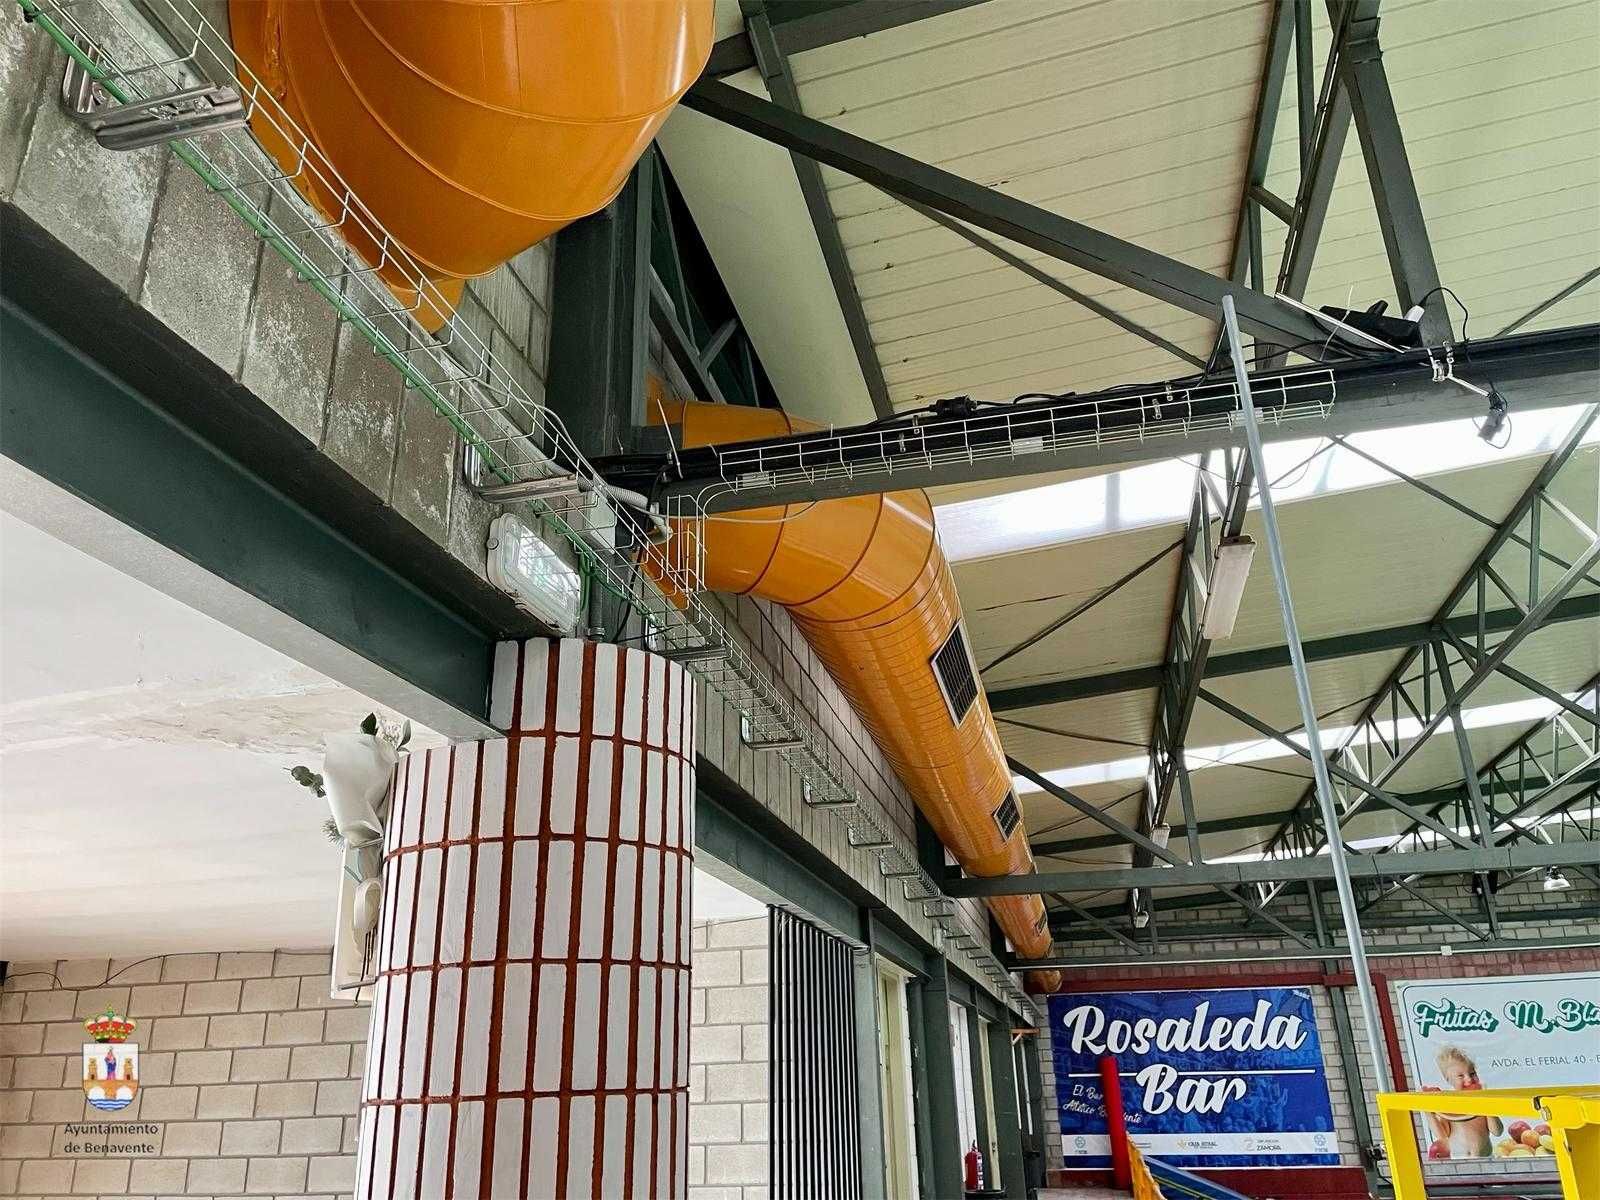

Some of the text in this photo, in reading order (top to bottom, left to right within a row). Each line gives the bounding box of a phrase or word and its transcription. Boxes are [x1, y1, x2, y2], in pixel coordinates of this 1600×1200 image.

[1063, 999, 1308, 1055] Rosaleda
[1413, 998, 1499, 1038] Frutas
[1525, 1057, 1537, 1067] EL
[1538, 1055, 1571, 1066] FERIAL
[1136, 1063, 1246, 1115] Bar
